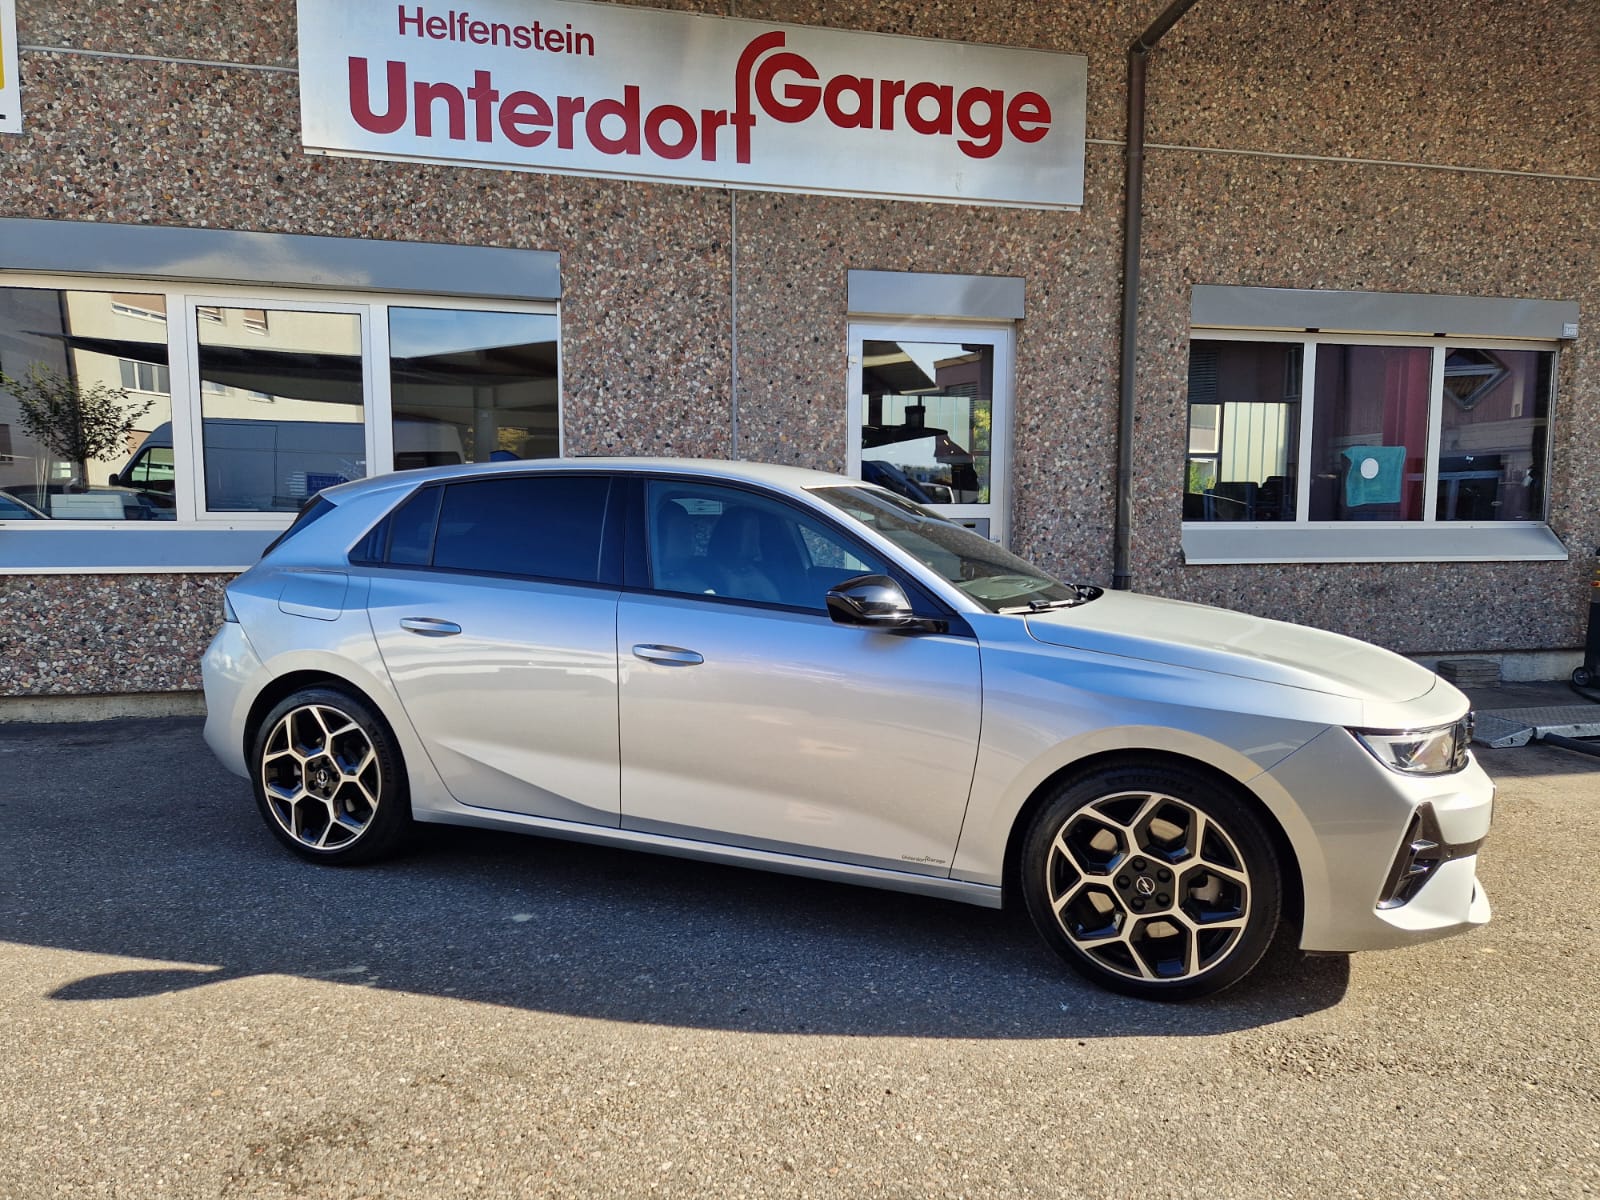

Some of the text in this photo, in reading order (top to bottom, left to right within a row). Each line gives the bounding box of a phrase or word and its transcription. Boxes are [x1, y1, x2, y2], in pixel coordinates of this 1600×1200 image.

[399, 6, 595, 56] Helfenstein
[348, 31, 1053, 164] Unterdorf Garage
